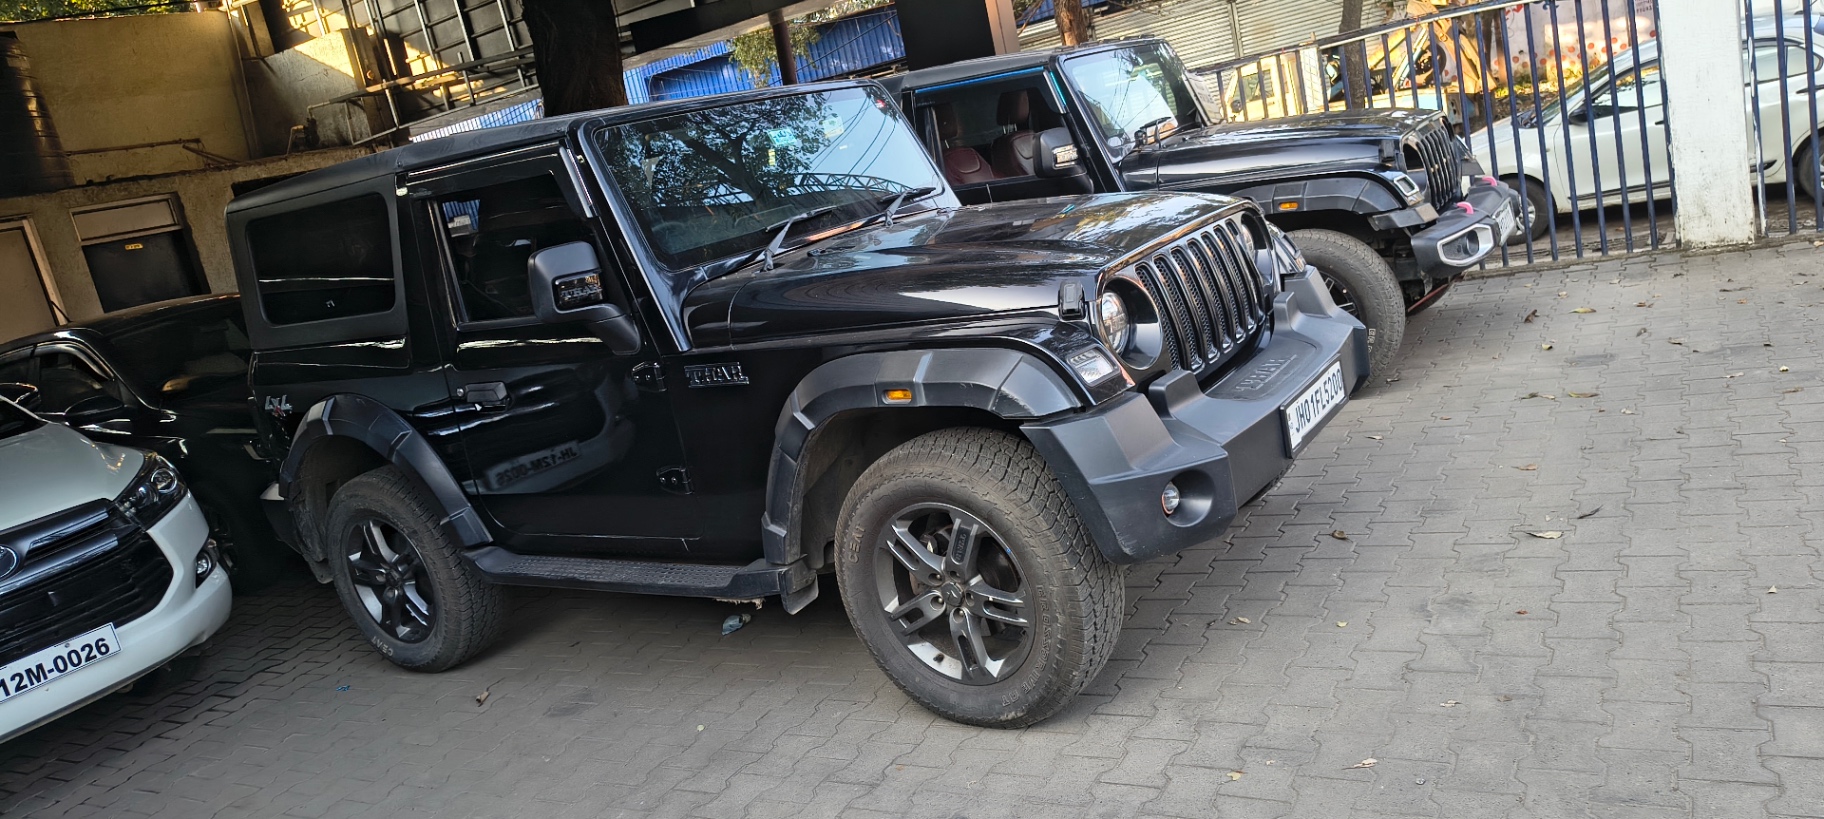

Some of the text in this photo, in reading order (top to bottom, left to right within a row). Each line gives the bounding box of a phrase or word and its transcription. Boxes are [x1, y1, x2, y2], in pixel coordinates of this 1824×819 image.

[684, 361, 749, 388] THAR
[1295, 368, 1343, 433] JH01FL5200
[371, 635, 394, 657] CEAT
